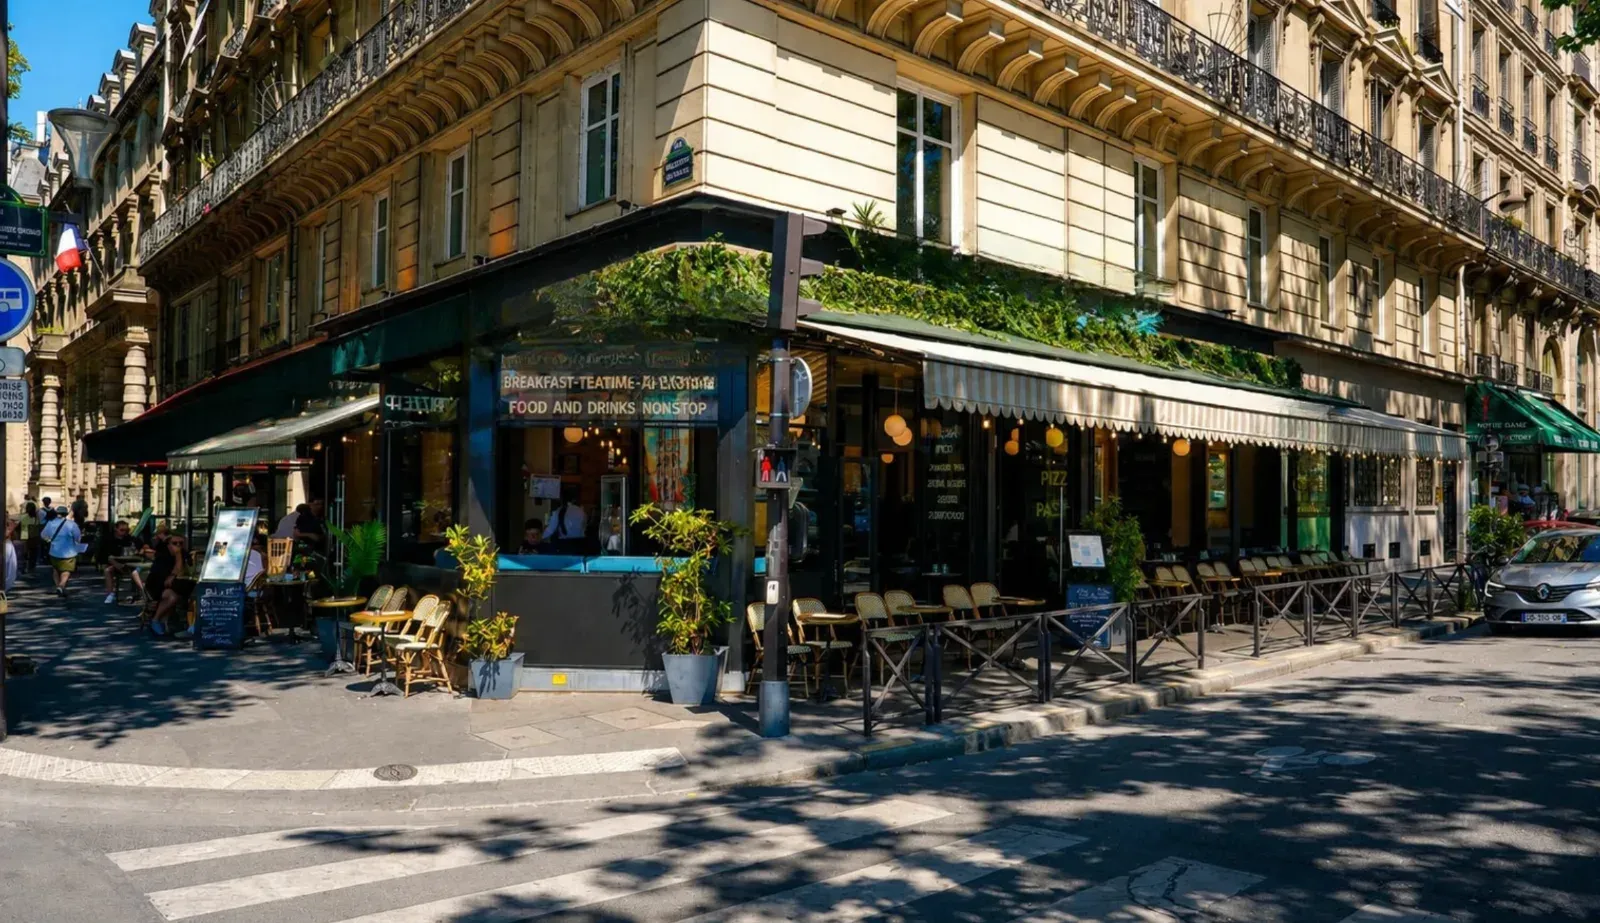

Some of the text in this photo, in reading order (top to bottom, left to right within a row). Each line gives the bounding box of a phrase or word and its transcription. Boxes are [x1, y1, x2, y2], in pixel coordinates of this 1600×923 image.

[509, 401, 707, 416] FOOD AND DRINKS NONSTOP
